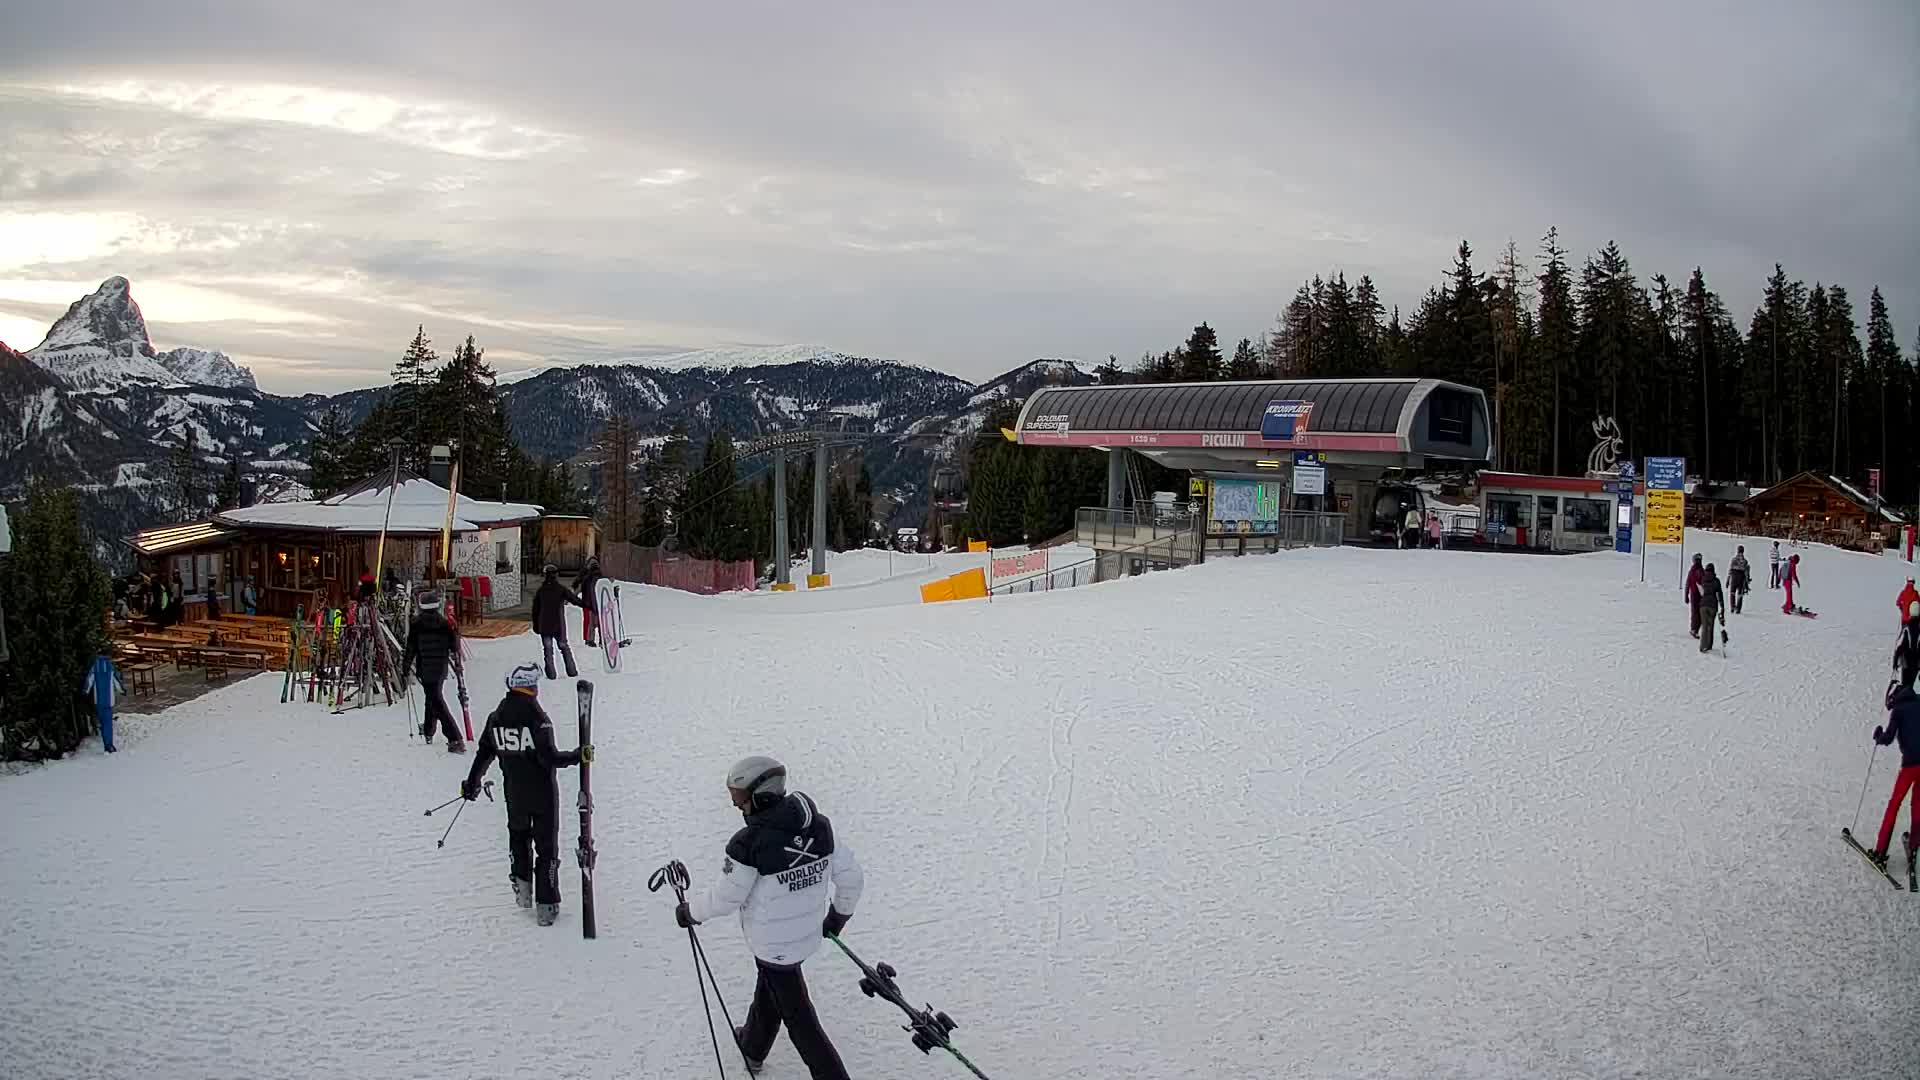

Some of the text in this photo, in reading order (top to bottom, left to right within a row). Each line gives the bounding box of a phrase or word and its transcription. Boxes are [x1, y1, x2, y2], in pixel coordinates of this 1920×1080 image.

[1266, 405, 1311, 413] KRONPLATZ
[1202, 434, 1245, 447] PICULIN
[493, 726, 536, 752] USA
[776, 859, 829, 885] WORLDCUP
[789, 873, 823, 892] REBELS
